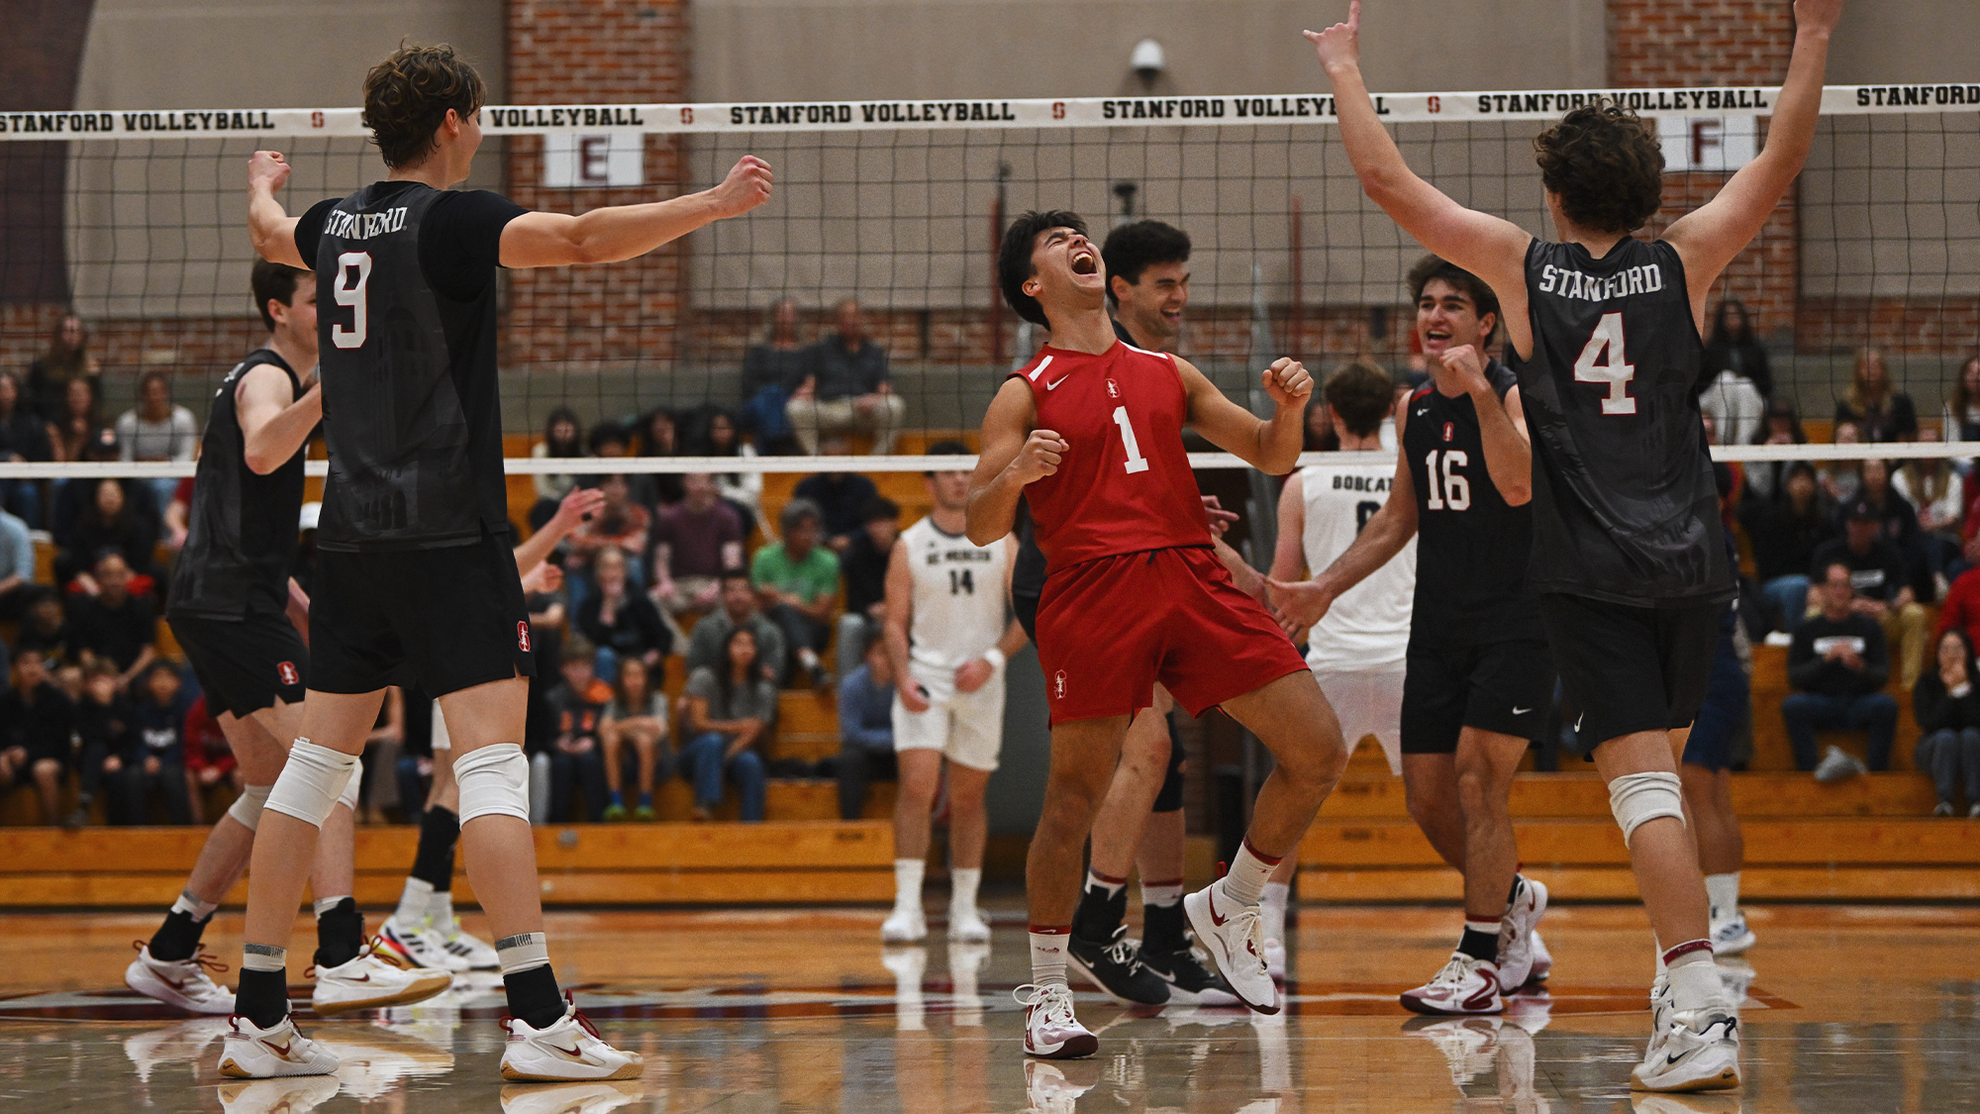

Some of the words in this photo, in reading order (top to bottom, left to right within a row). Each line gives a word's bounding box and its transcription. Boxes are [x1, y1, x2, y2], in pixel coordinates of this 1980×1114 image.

[1103, 99, 1225, 119] STANFORD
[1234, 97, 1389, 117] VOLLEYL
[1611, 90, 1767, 110] VOLLEYBALL
[1857, 86, 1980, 106] STANFORD
[0, 113, 113, 132] STANFORD
[123, 112, 275, 131] VOLLEYBALL
[491, 107, 643, 128] VOLLEYBALL
[731, 104, 852, 125] STANFORD
[861, 102, 1015, 122] VOLLEYBALL
[1691, 120, 1720, 165] F
[579, 137, 608, 183] E
[324, 206, 408, 240] STANFORD
[1539, 263, 1662, 302] STANFORD
[331, 250, 373, 349] 9
[1573, 311, 1637, 415] 4
[1112, 405, 1149, 474] 1
[1332, 475, 1393, 493] BOBCAT
[1425, 449, 1471, 511] 16
[950, 569, 974, 595] 14
